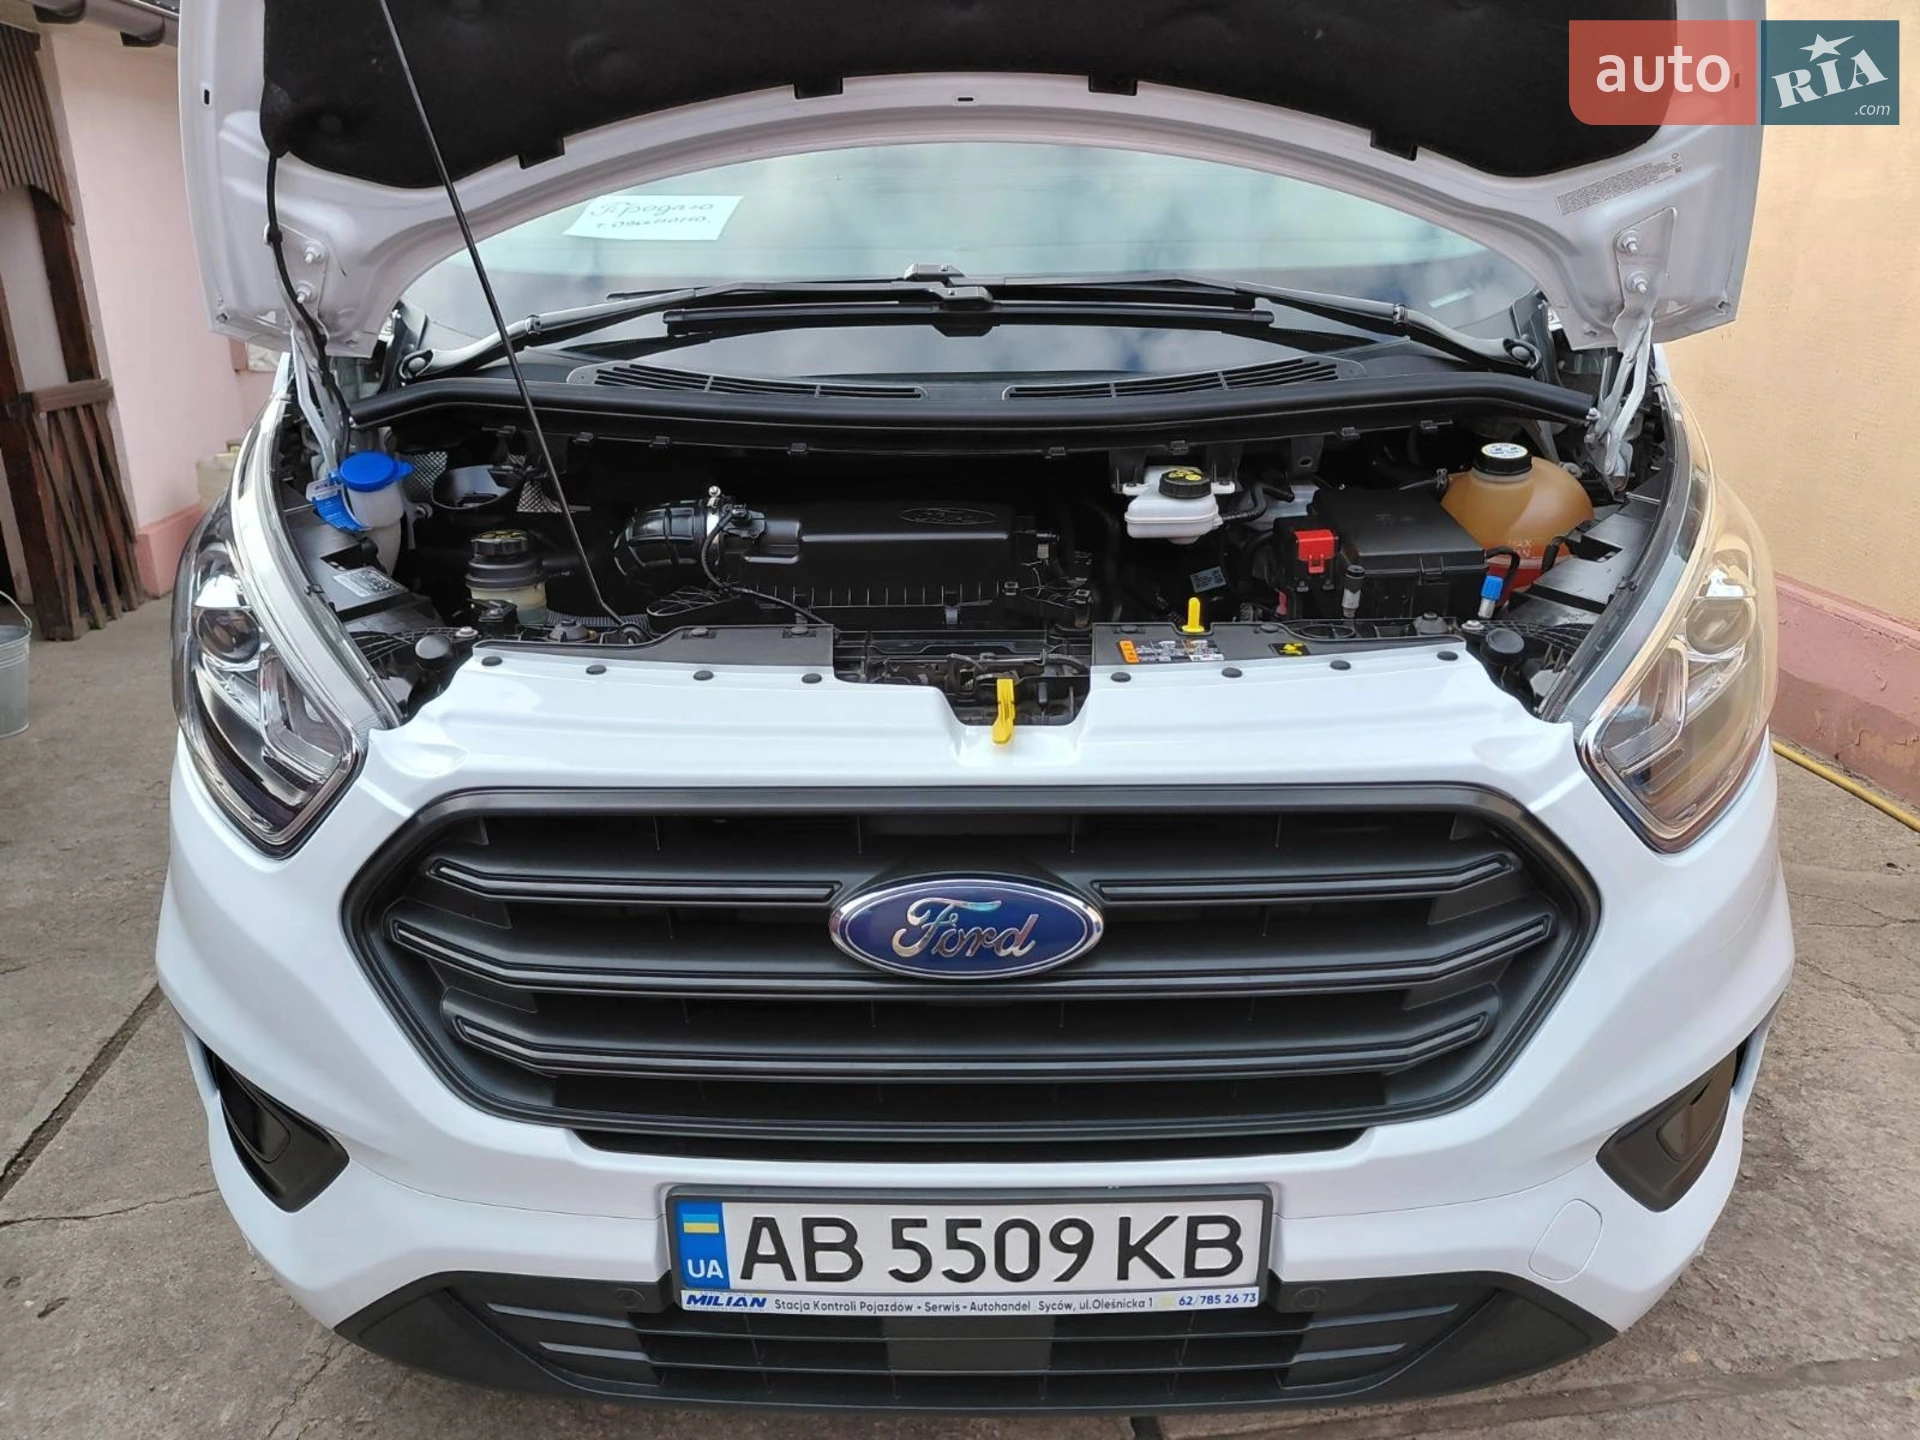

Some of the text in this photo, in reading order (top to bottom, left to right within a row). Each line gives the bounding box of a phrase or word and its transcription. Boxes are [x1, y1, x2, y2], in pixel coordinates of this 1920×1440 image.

[891, 897, 1039, 958] Ford
[740, 1214, 1244, 1284] AB 5509 KB
[687, 1259, 724, 1279] UA
[686, 1294, 768, 1308] MILIAN
[774, 1299, 811, 1312] Stacja
[813, 1301, 857, 1312] Kontroli
[859, 1301, 914, 1314] Pojazdów
[924, 1301, 961, 1313] Serwis
[969, 1301, 1031, 1312] Autohandel
[1224, 1293, 1240, 1304] 26
[1242, 1292, 1257, 1303] 73
